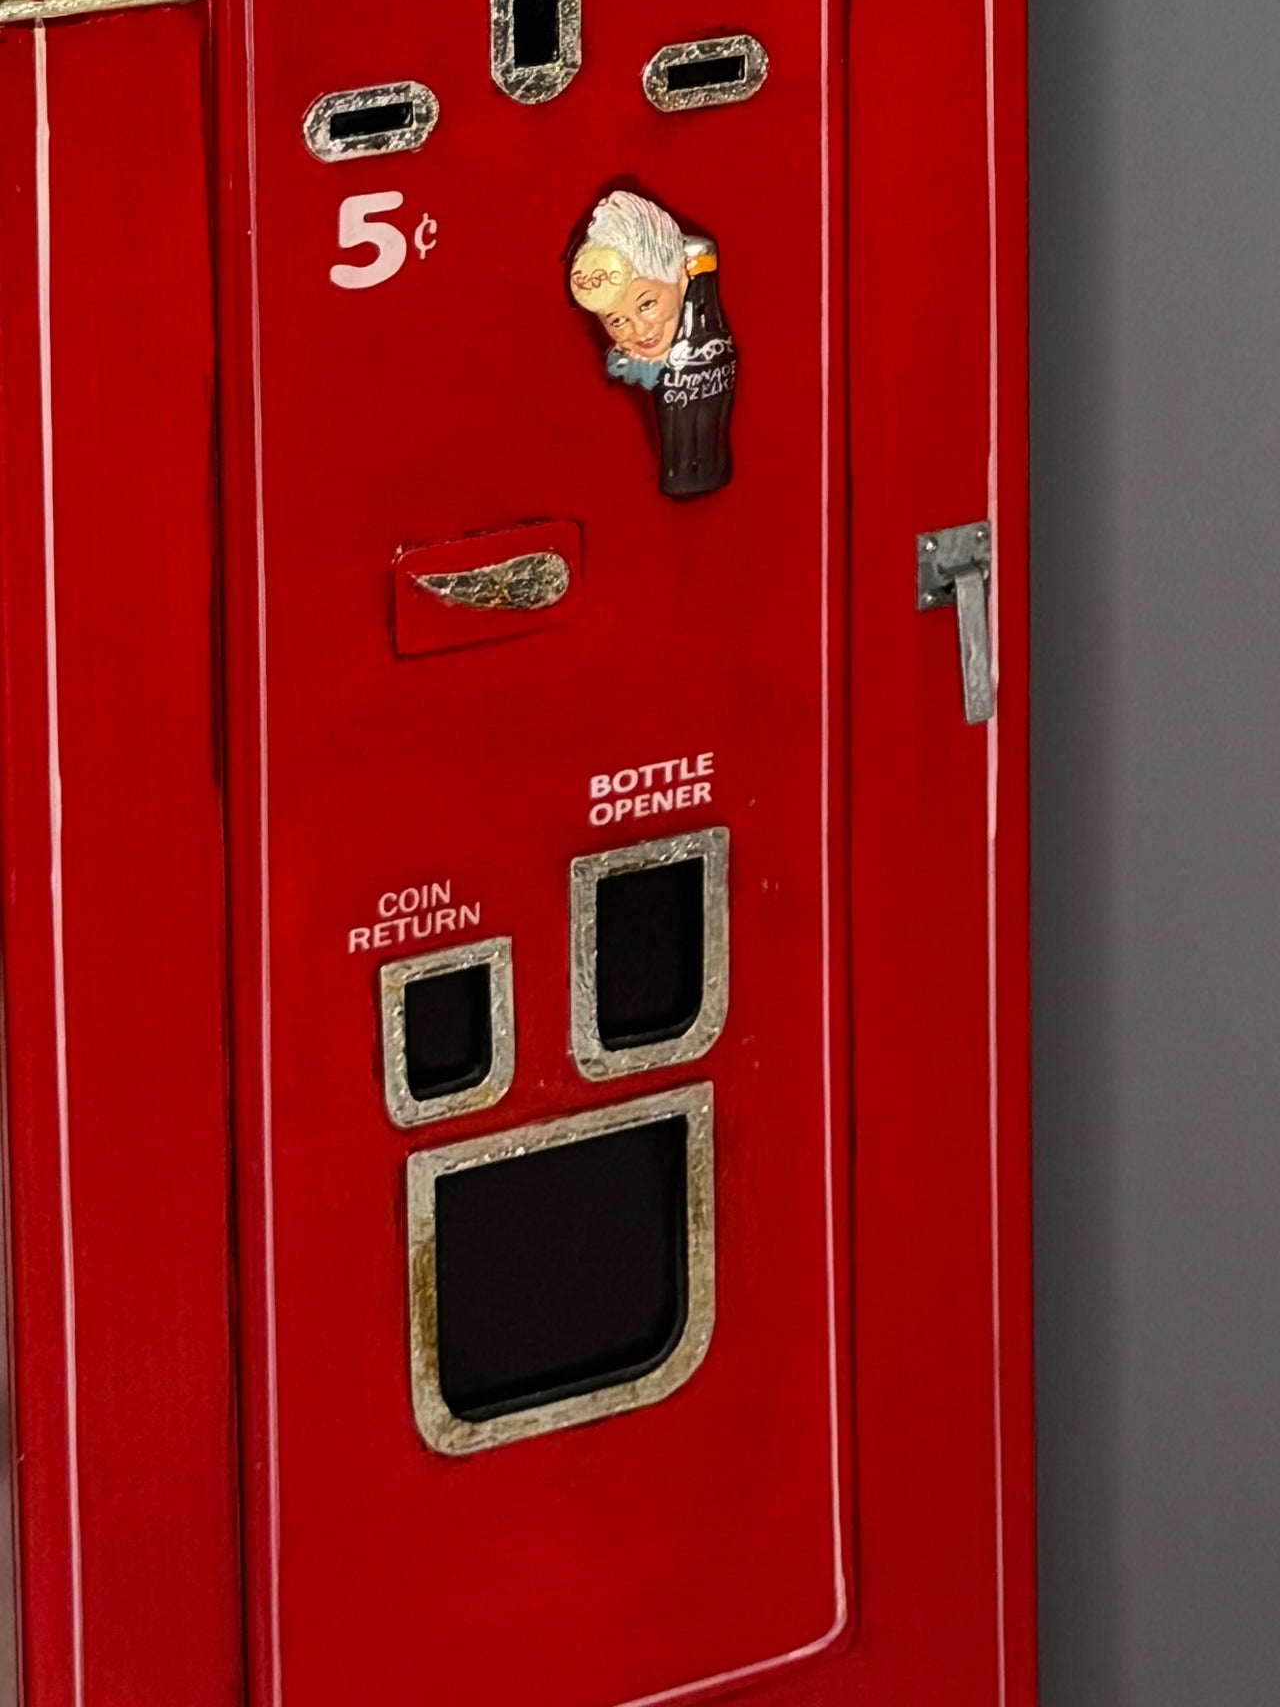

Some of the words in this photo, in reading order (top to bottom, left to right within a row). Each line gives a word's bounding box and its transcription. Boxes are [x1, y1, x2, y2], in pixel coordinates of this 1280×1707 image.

[589, 751, 715, 799] BOTTLE
[588, 781, 712, 826] OPENER
[378, 879, 451, 918] COIN
[348, 901, 481, 954] RETURN
